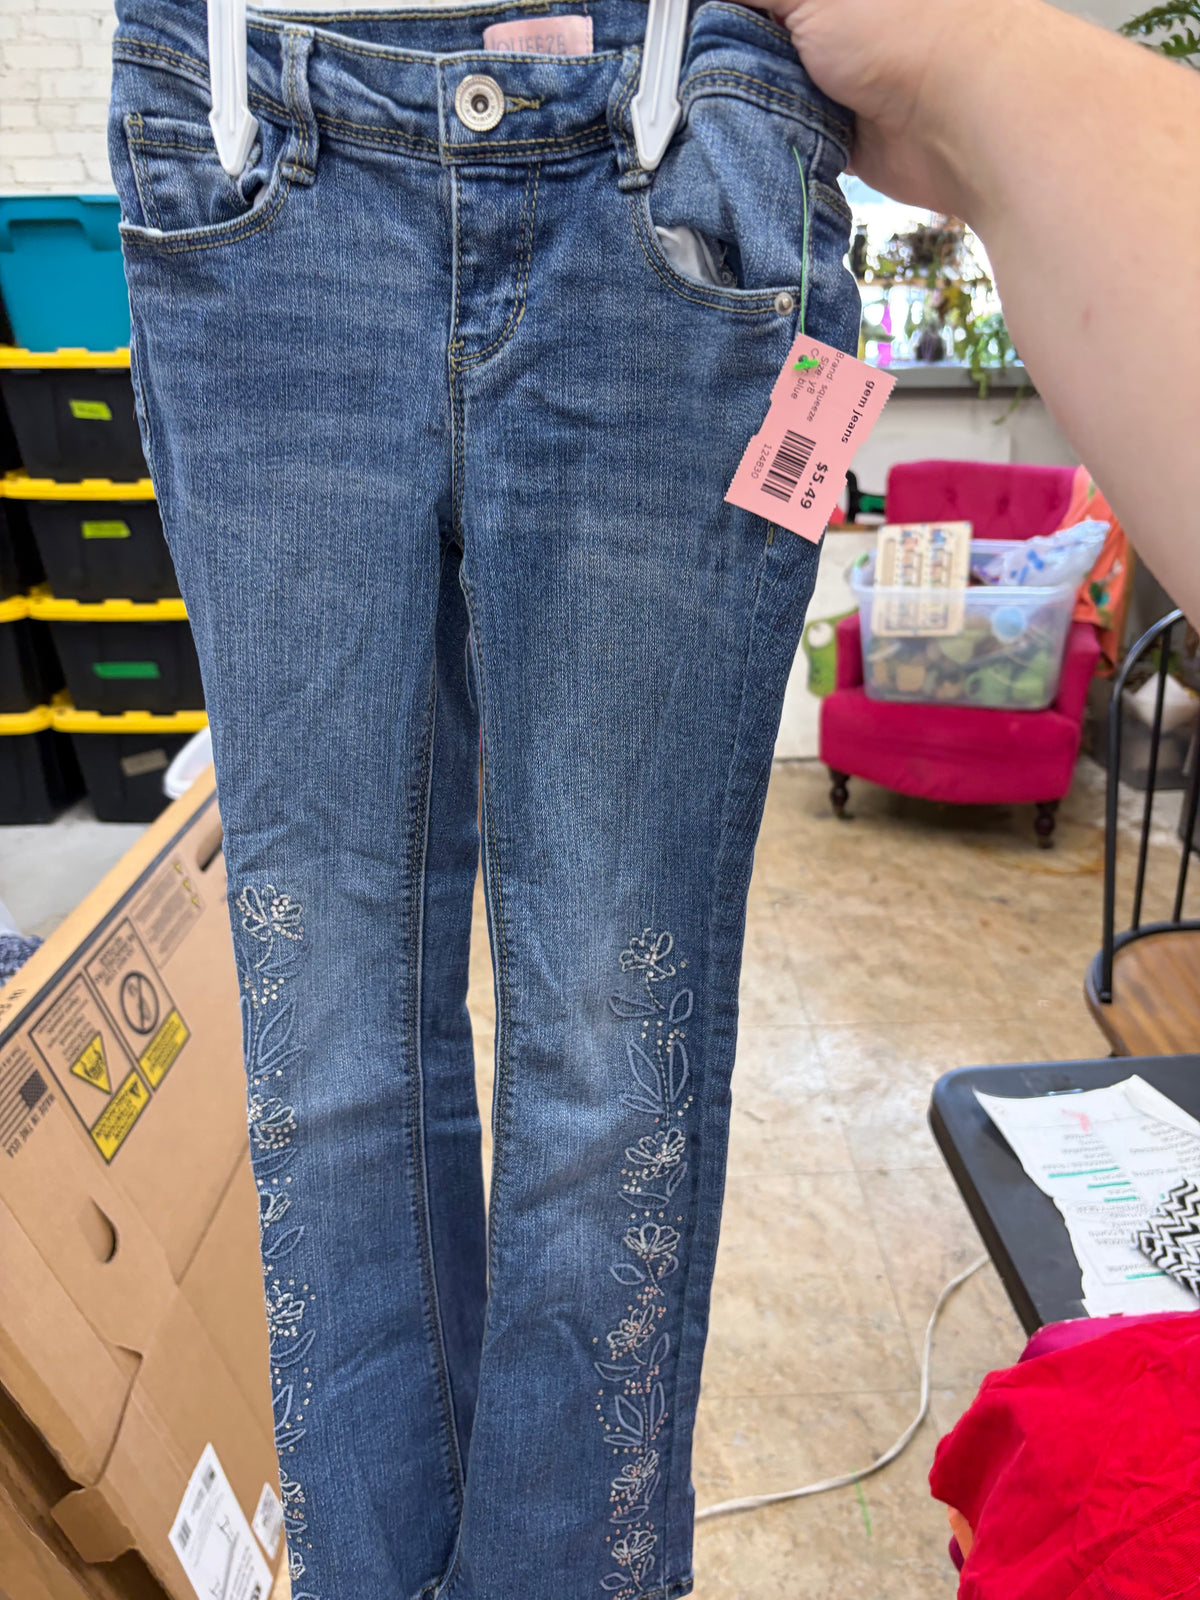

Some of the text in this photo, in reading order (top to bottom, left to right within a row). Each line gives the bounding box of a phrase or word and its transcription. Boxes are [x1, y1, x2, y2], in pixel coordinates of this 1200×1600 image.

[790, 377, 807, 400] blue
[806, 379, 817, 395] y8
[806, 384, 828, 422] squeeze
[841, 379, 875, 444] gem jeans
[751, 444, 771, 479] 124830
[800, 462, 828, 510] $5.49
